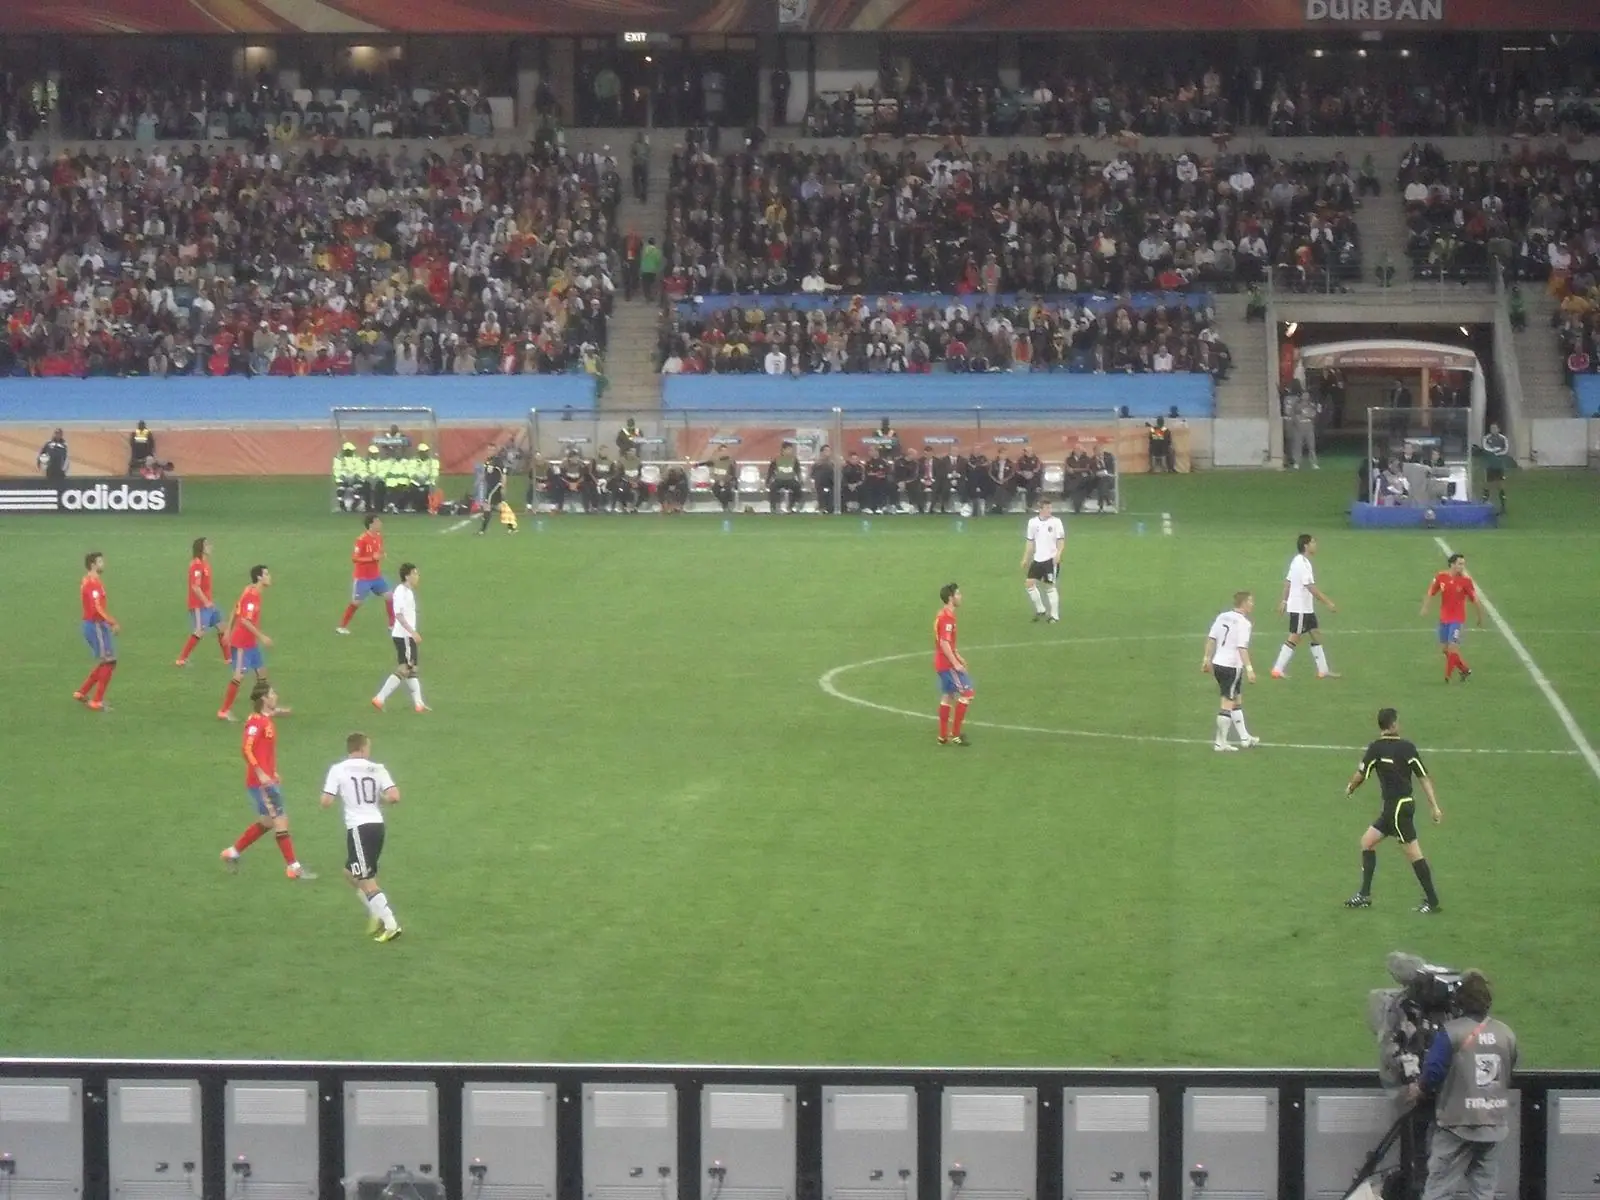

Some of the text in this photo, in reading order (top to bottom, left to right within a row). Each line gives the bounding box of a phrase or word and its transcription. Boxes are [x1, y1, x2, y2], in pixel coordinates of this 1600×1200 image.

[1306, 0, 1443, 21] DURBAN
[624, 31, 648, 42] EXIT
[61, 484, 166, 511] adidas
[1222, 623, 1230, 647] 7
[350, 776, 376, 805] 10
[350, 862, 361, 876] 10
